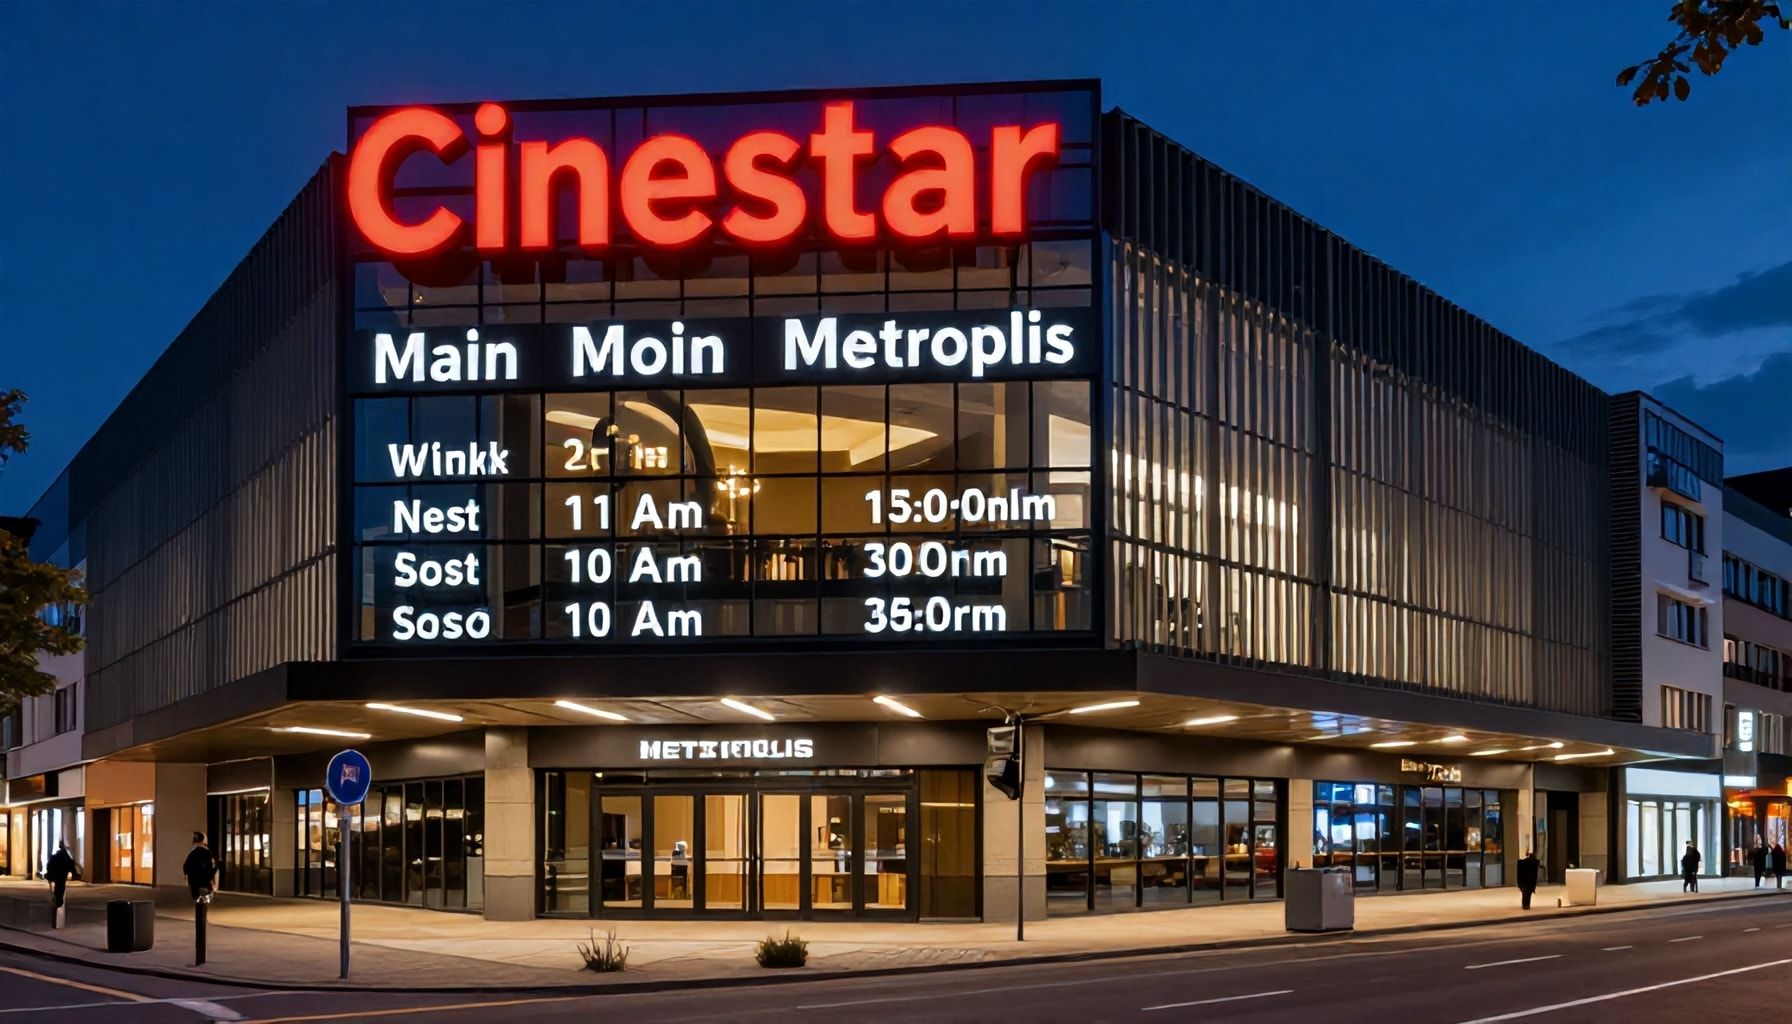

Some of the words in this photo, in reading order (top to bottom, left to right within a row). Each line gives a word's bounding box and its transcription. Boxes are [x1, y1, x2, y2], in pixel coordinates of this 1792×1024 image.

[347, 102, 1059, 255] Cinestar
[376, 329, 518, 384] Main
[572, 322, 724, 377] Moin
[785, 309, 1075, 378] Metroplis
[393, 499, 480, 534] Nest
[630, 493, 703, 530] Am
[394, 552, 480, 588] Sost
[564, 548, 612, 584] 10
[628, 546, 702, 584] Am
[392, 605, 491, 641] Soso
[564, 601, 611, 638] 10
[631, 600, 702, 637] Am
